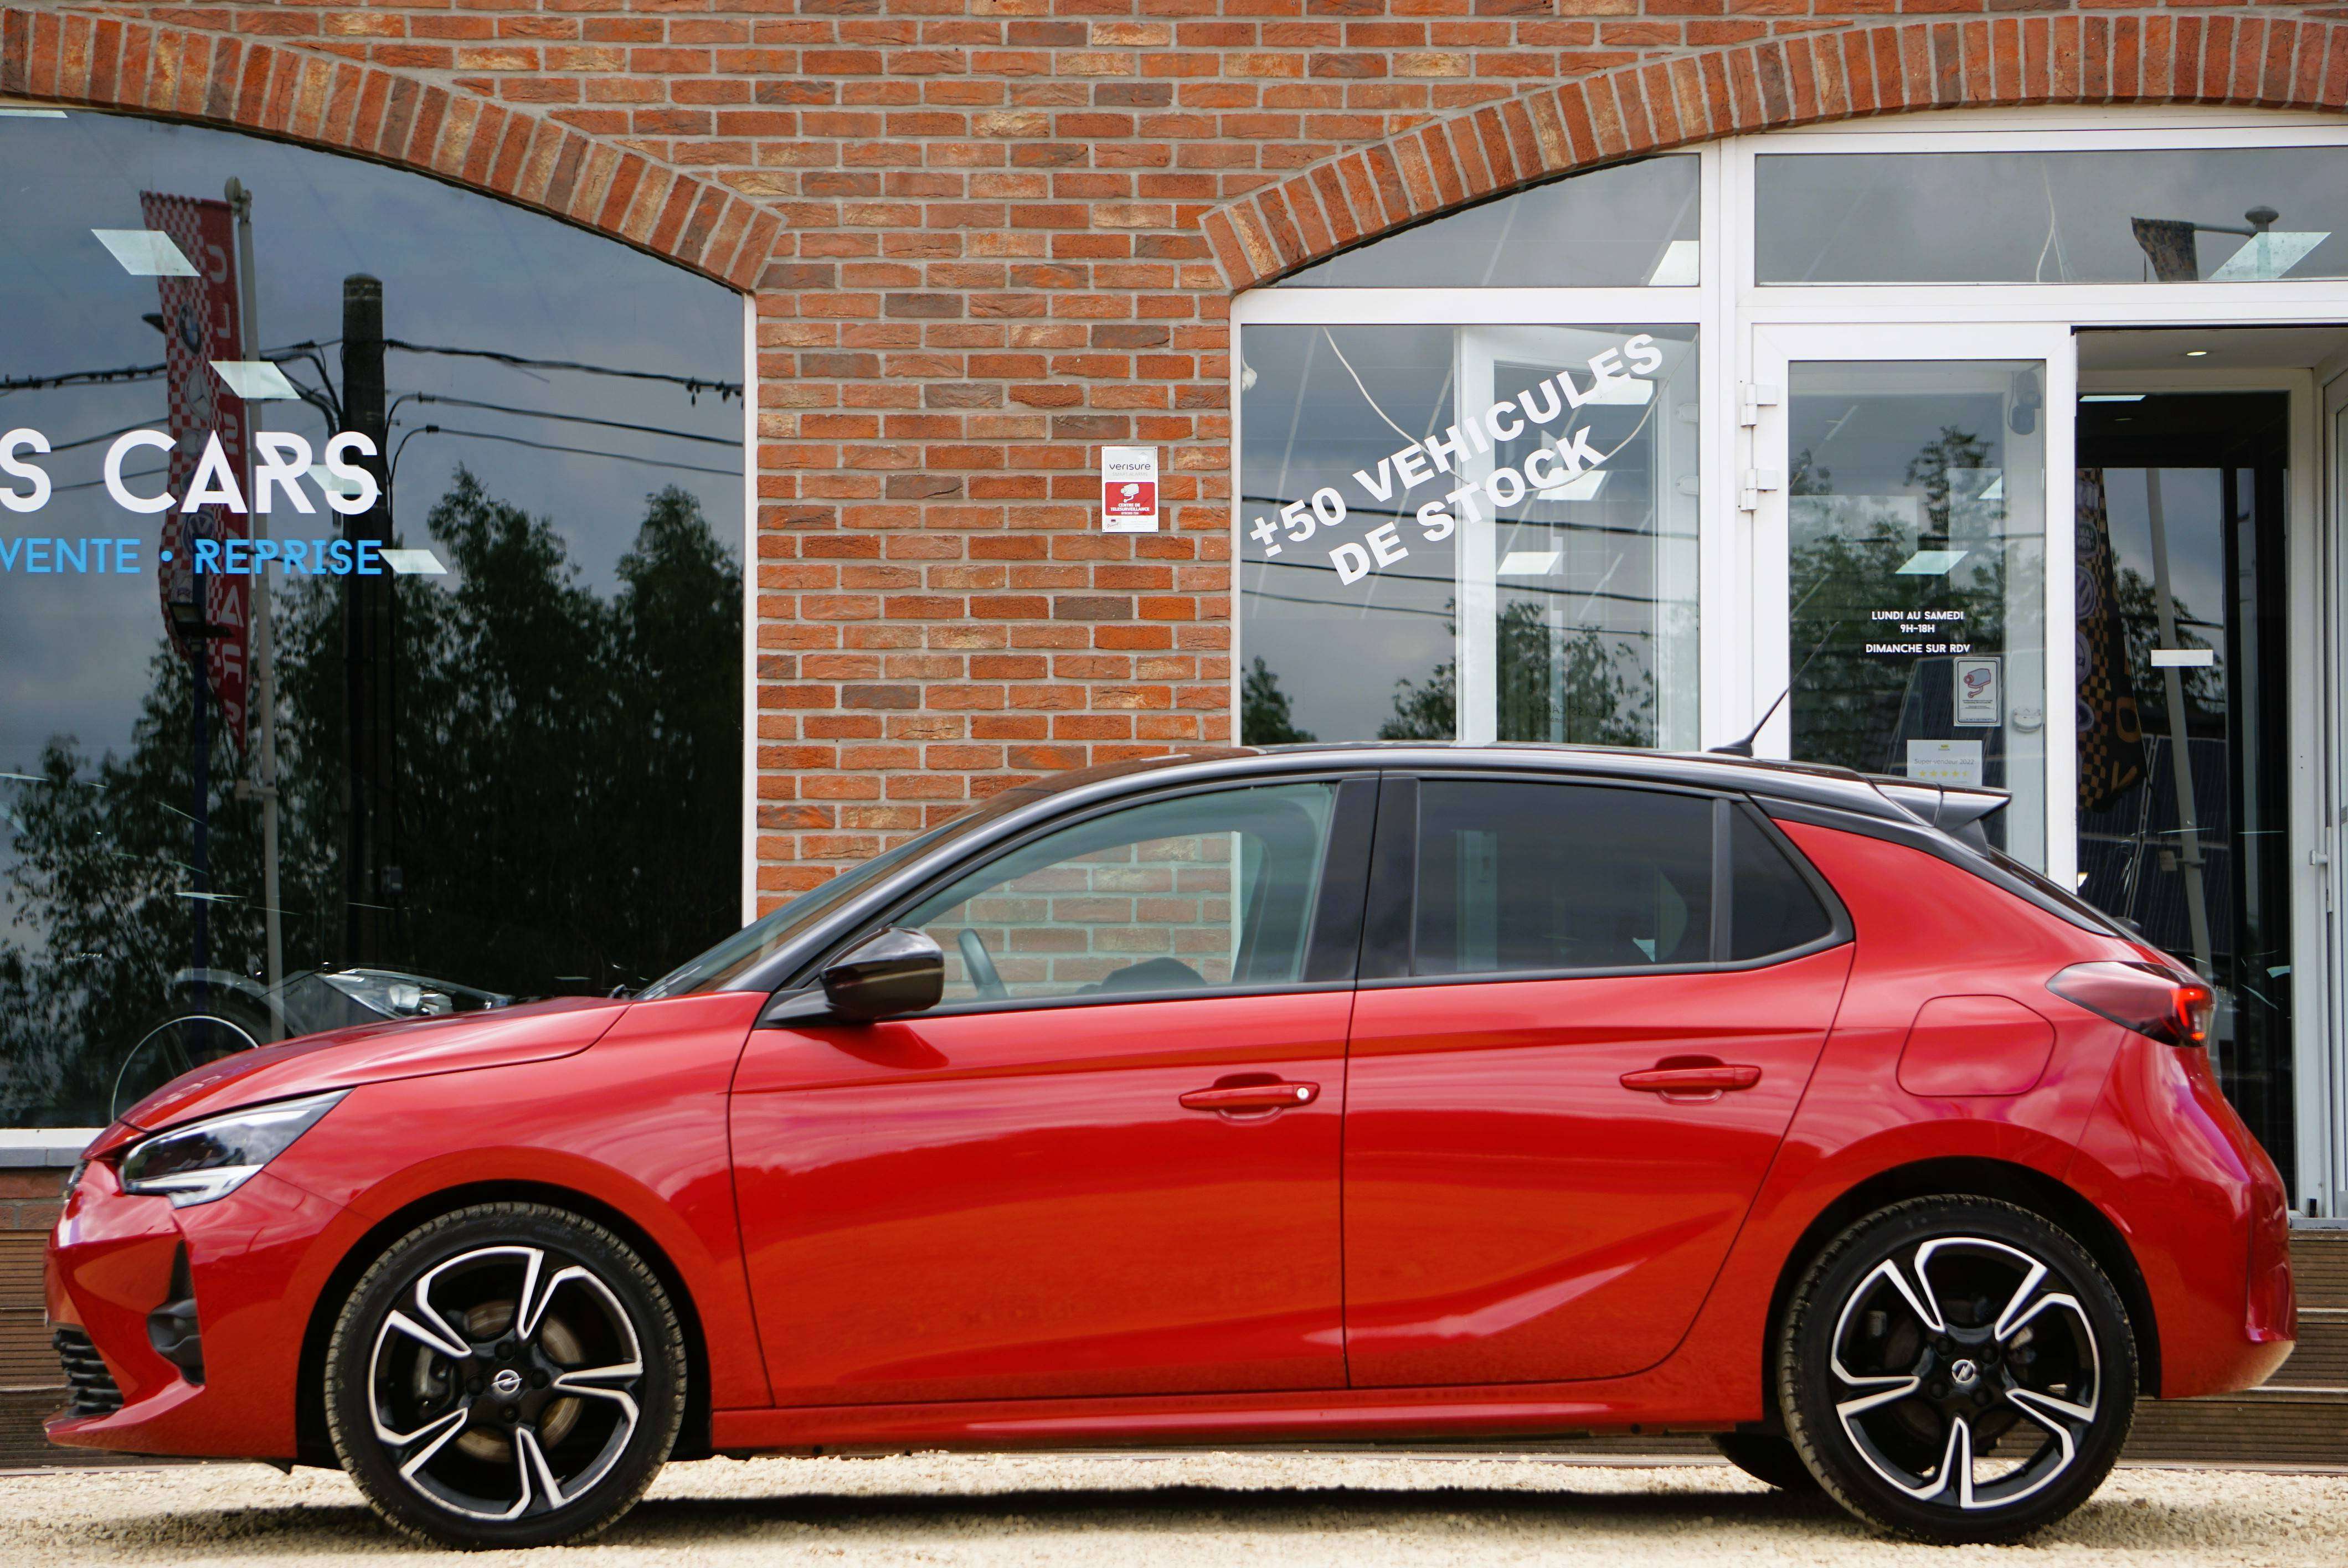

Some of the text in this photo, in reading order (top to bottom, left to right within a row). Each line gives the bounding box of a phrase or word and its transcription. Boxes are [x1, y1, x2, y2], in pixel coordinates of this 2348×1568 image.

[1352, 334, 1663, 503] VEHICULES
[0, 428, 379, 515] S CARS
[1328, 425, 1607, 586] DE STOCK
[0, 538, 382, 575] VENTE REPRISE
[1872, 611, 1964, 620] LUNDI AU SAMEDI
[1900, 624, 1935, 633] 9H-18H
[1866, 644, 1971, 653] DIMANCHE SUR RDV
